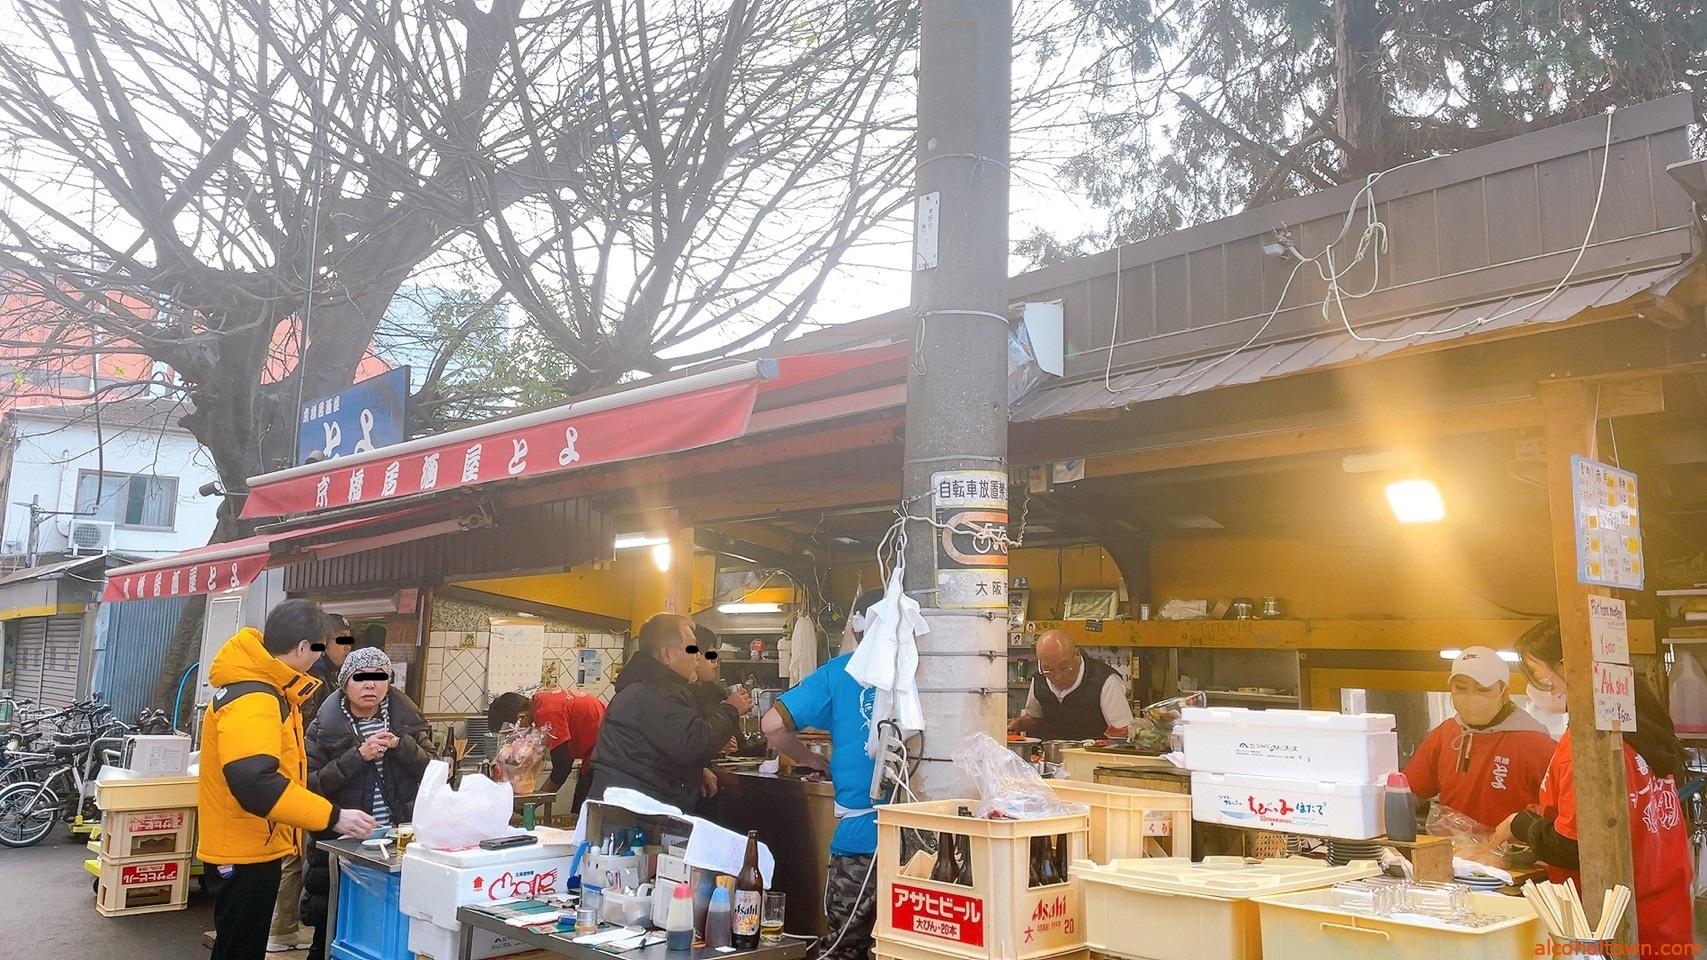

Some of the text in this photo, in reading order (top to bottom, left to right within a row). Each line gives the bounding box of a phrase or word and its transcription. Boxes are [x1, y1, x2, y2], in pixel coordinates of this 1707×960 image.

[893, 887, 981, 924] アサヒビール
[1031, 894, 1067, 921] Asahi
[1024, 926, 1034, 943] 大
[1064, 918, 1075, 934] 20
